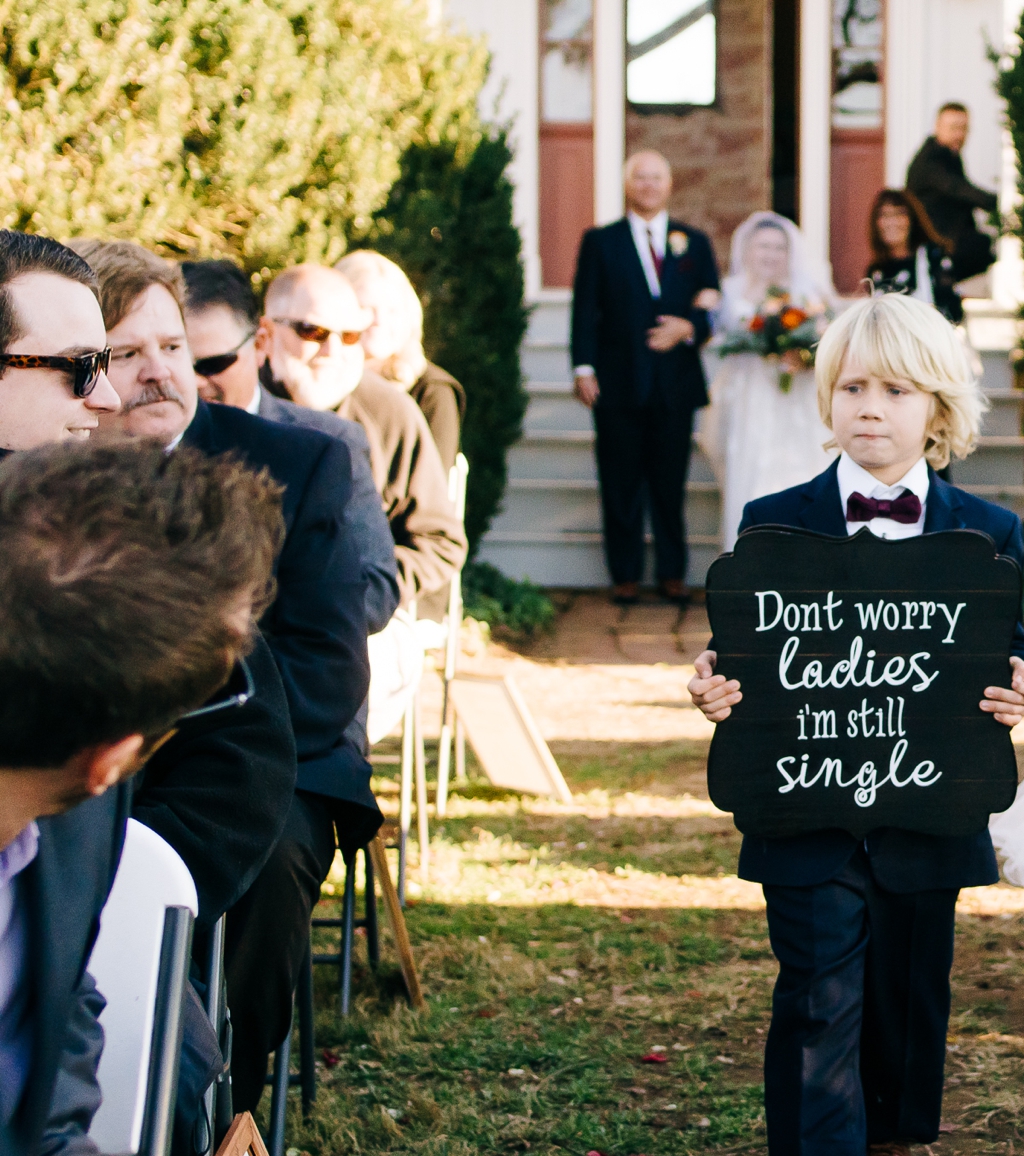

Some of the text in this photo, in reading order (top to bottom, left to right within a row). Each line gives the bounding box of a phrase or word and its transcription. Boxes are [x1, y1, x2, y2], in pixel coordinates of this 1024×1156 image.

[754, 590, 967, 644] Dont worry
[778, 636, 940, 692] ladies
[797, 696, 907, 740] i'm still
[776, 739, 943, 808] single
